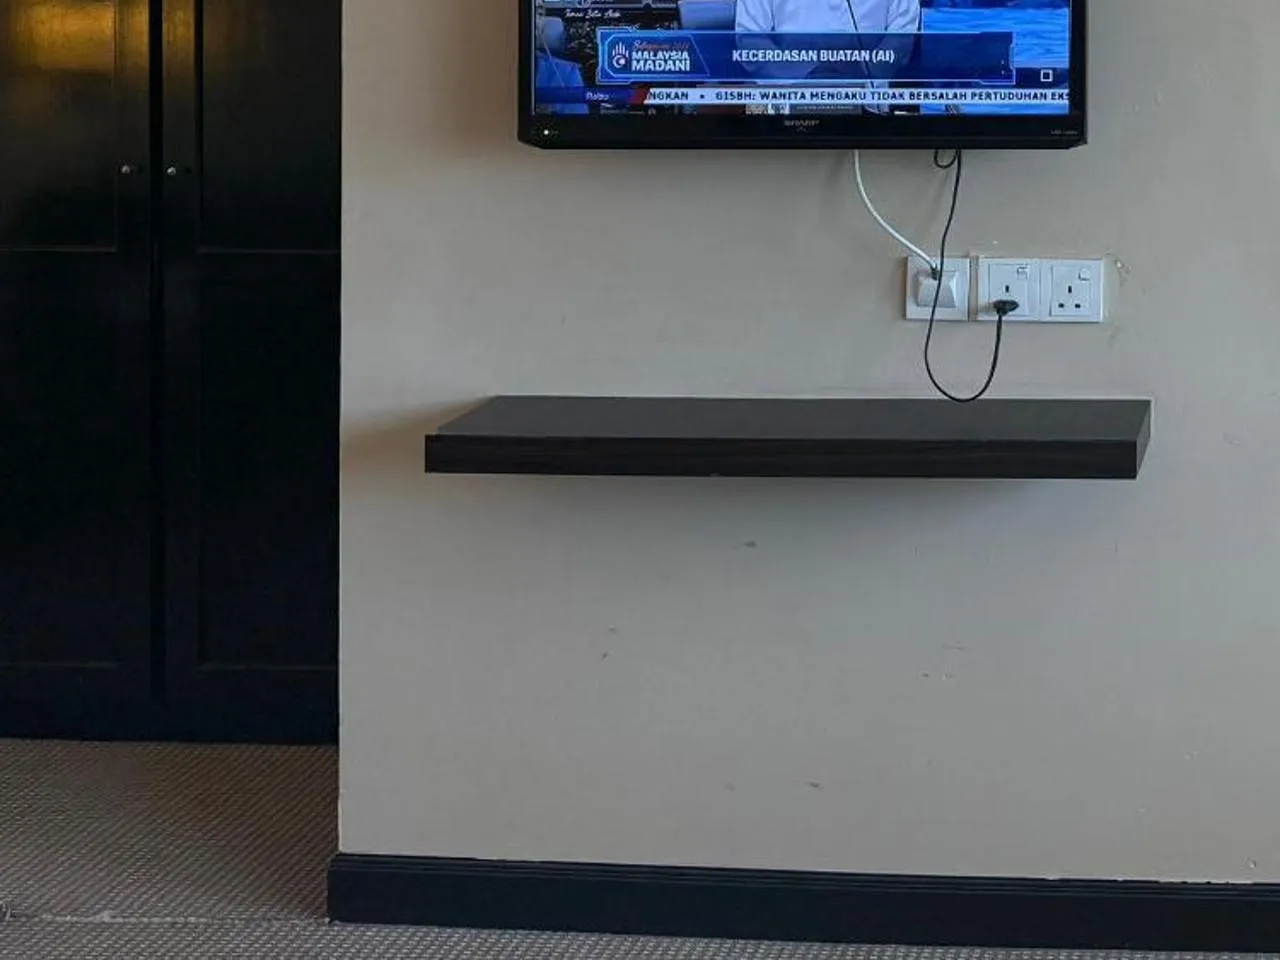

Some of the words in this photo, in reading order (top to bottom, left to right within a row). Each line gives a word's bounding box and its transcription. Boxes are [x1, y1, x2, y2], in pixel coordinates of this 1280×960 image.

[631, 50, 690, 60] MALAYSIA
[732, 49, 817, 62] KECERDASAN
[820, 50, 870, 62] BUATAN
[871, 50, 896, 63] (AI)
[631, 60, 691, 72] MADANI
[759, 91, 806, 101] WANITA
[810, 91, 866, 101] MENGAKU
[870, 91, 905, 101] TIDAK
[908, 91, 966, 101] BERSALAH
[970, 91, 1047, 101] PERTUDUHAN
